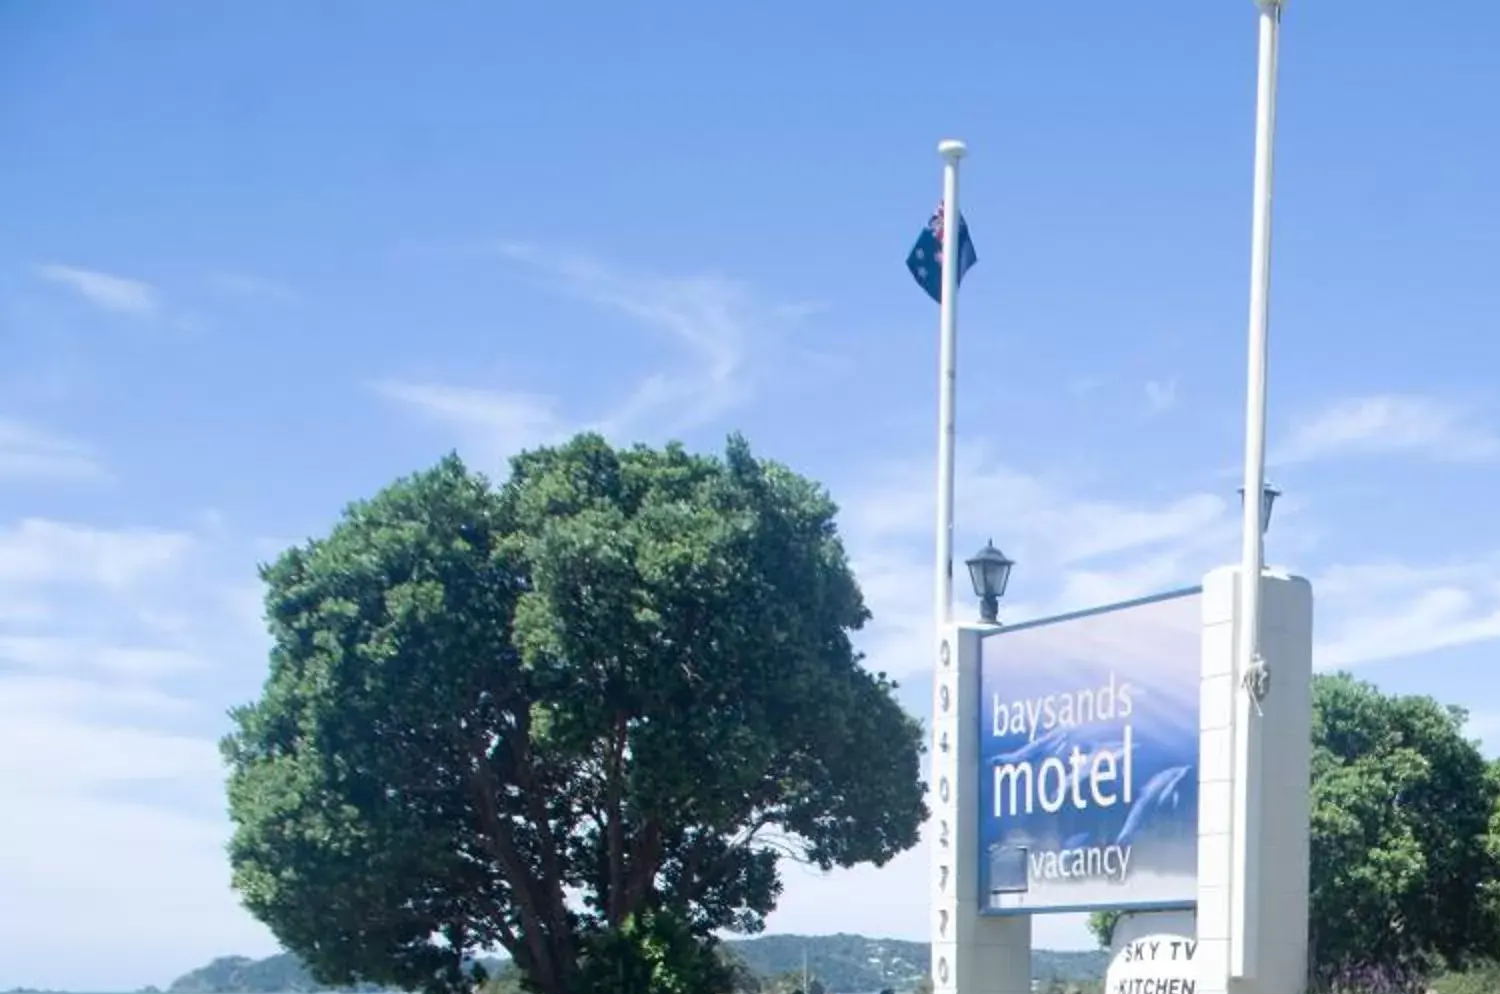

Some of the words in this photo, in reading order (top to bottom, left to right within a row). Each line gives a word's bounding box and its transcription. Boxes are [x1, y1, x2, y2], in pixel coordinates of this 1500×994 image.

[992, 671, 1132, 746] baysands
[993, 724, 1132, 817] motel
[1030, 845, 1131, 882] vacancy
[1124, 941, 1160, 963] SKY
[1170, 941, 1198, 961] TV
